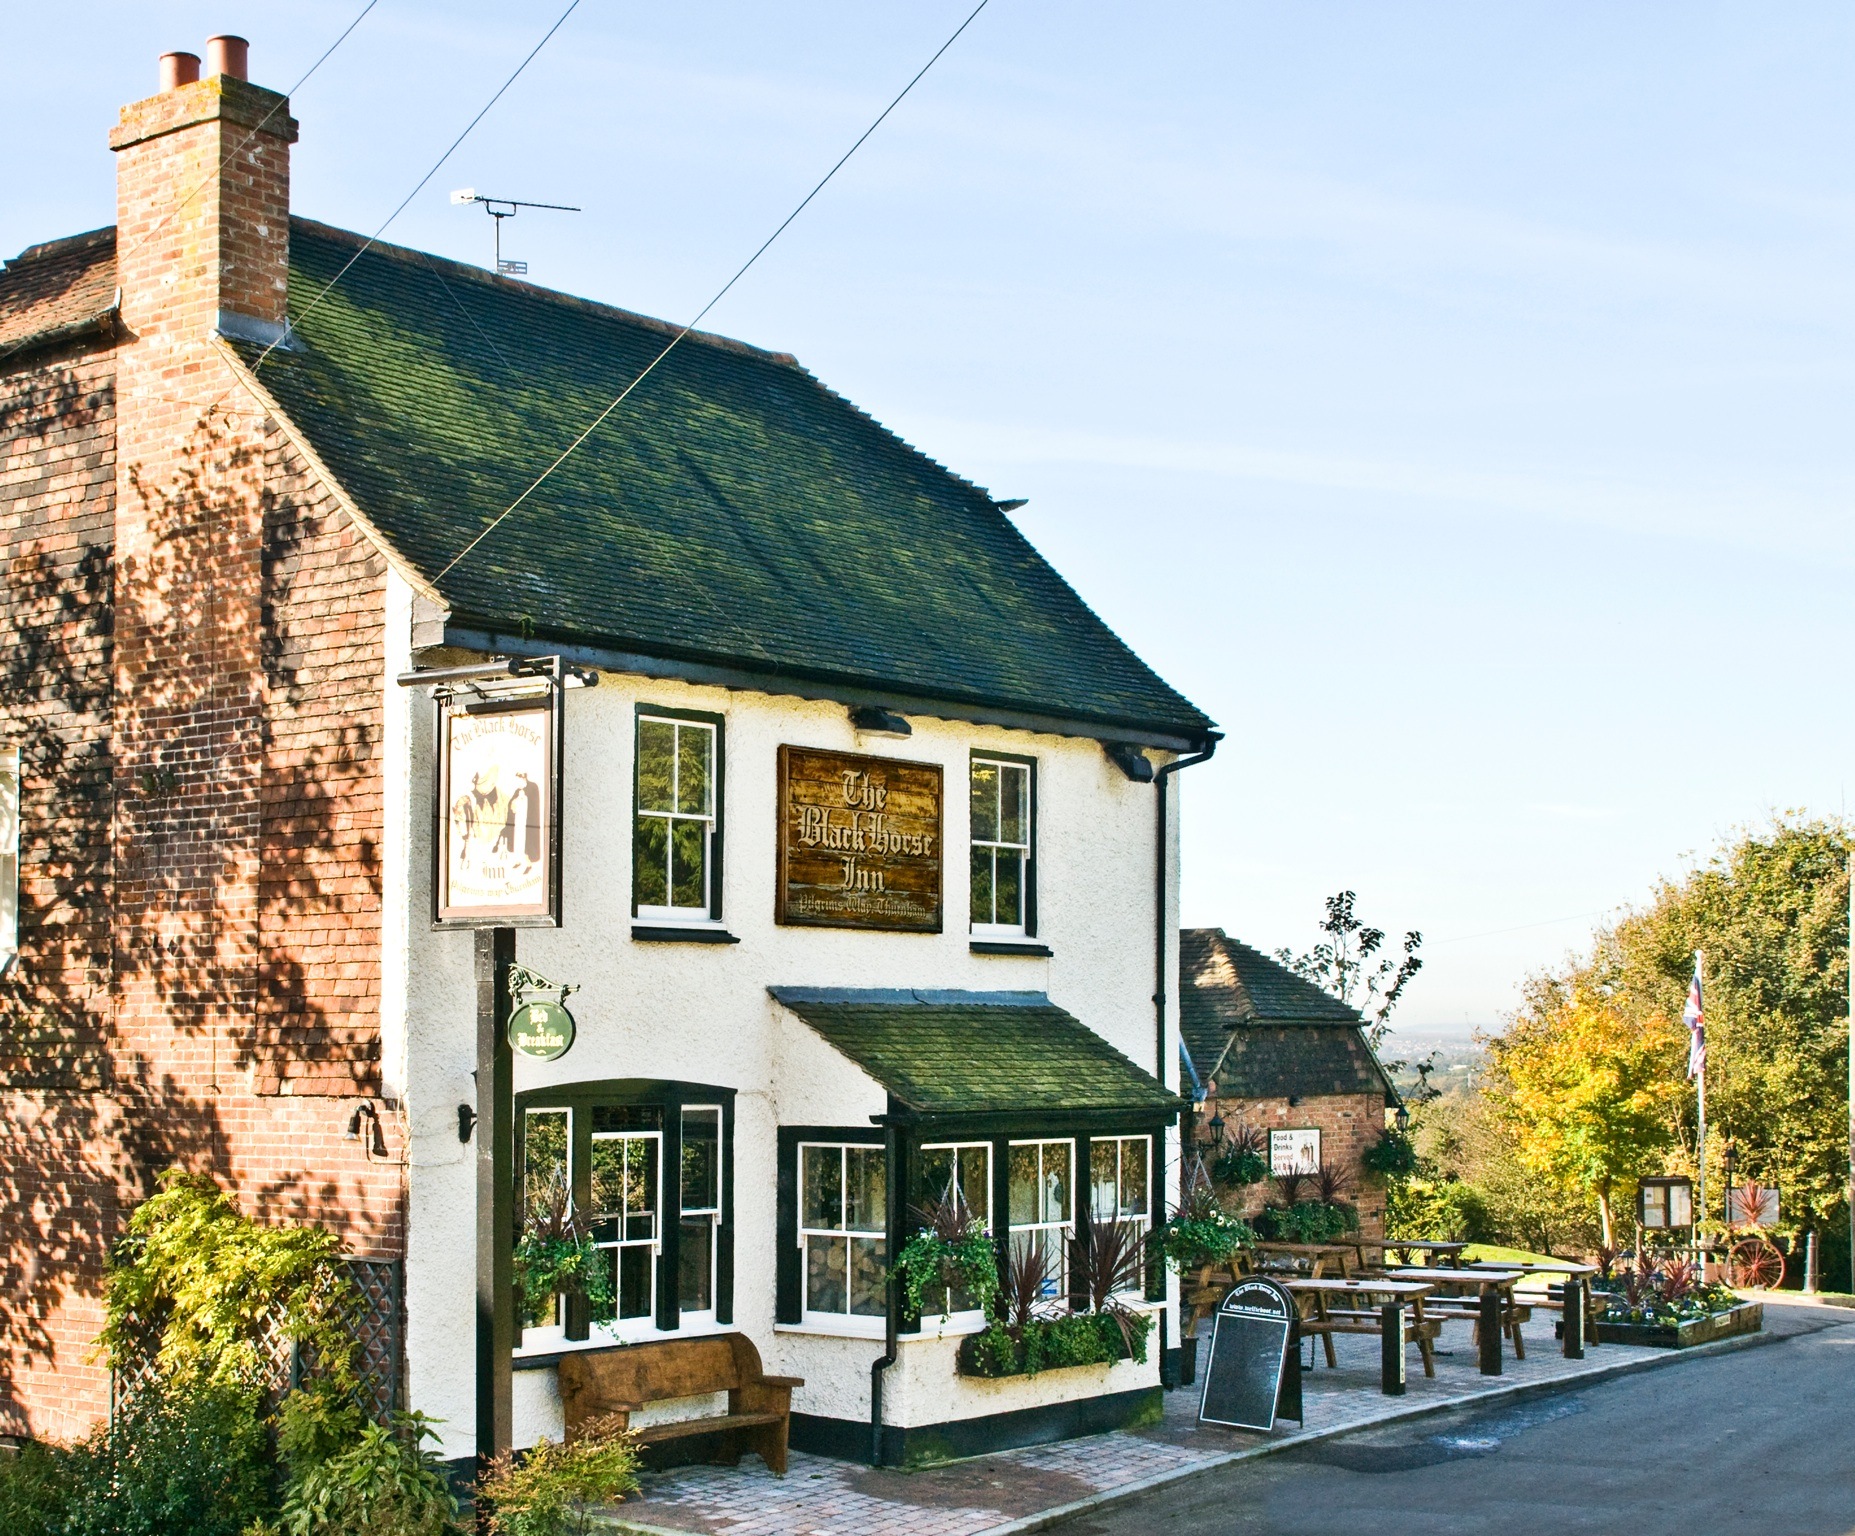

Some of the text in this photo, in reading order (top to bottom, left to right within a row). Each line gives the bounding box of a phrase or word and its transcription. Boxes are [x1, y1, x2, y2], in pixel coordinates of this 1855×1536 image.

[452, 716, 541, 750] The Black Horse
[842, 769, 887, 811] The
[796, 805, 933, 860] Black Horse
[482, 861, 505, 879] Inn
[842, 856, 886, 892] Inn
[799, 893, 845, 914] Pilgrims
[875, 897, 928, 918] Thurnham
[529, 1008, 549, 1025] Bed
[536, 1023, 545, 1034] &
[517, 1032, 565, 1048] Breakfast
[1273, 1133, 1288, 1141] Food
[1289, 1133, 1294, 1141] &
[1273, 1143, 1293, 1151] Drinks
[1273, 1153, 1294, 1161] Served
